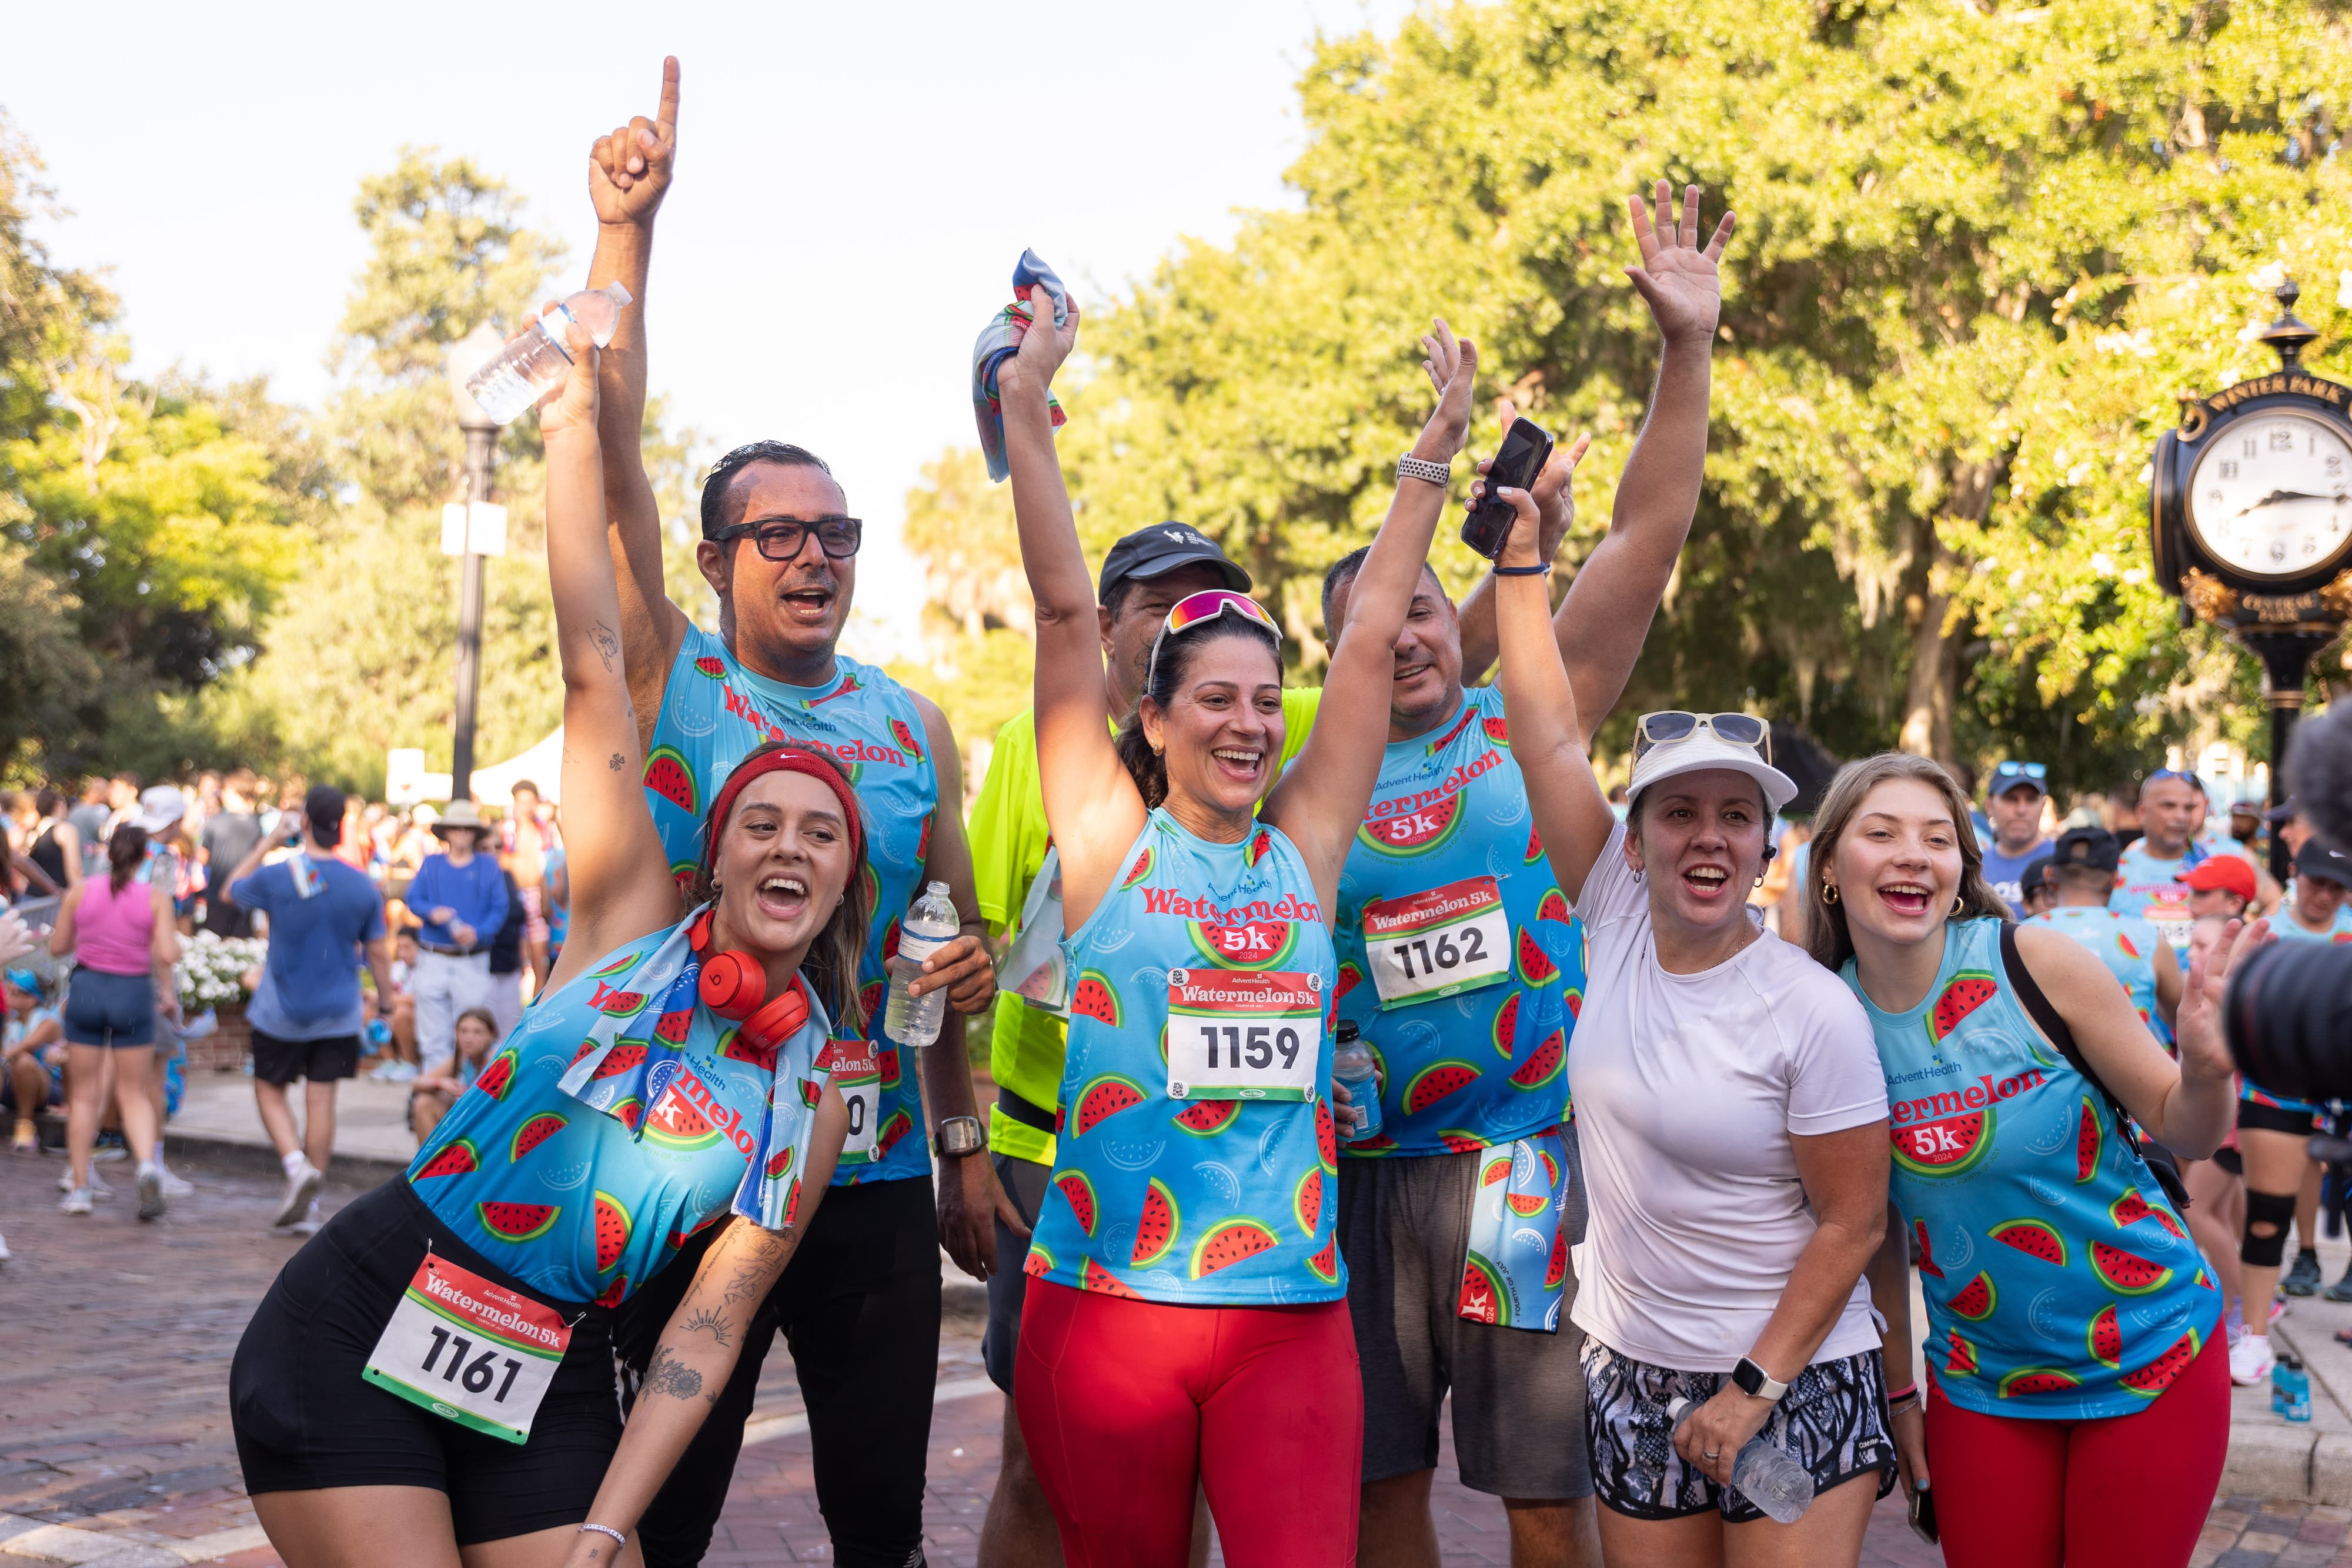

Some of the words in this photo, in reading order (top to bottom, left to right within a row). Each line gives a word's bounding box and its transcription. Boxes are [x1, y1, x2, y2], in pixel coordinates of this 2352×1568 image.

[2208, 375, 2287, 412] WINTER
[2289, 375, 2343, 404] PARK
[1375, 765, 1444, 792] AdventHealth
[1391, 813, 1440, 840] 5k
[1406, 833, 1428, 845] 2024
[1426, 844, 1452, 862] FOURTH
[1452, 836, 1460, 845] OF
[1459, 818, 1469, 835] JULY
[1138, 885, 1322, 927] Watermelon
[1371, 897, 1470, 931] Watermelon
[1469, 890, 1494, 905] 5k
[1412, 893, 1444, 905] AdventHealth
[1223, 925, 1272, 951] 5k
[1238, 951, 1258, 959] 2024
[1288, 957, 1300, 972] JULY
[1393, 927, 1489, 980] 1162
[1180, 985, 1295, 1004] Watermelon
[1296, 991, 1316, 1005] 5k
[1200, 1027, 1300, 1069] 1159
[830, 1057, 862, 1072] elon
[862, 1058, 876, 1072] 5k
[1887, 1062, 1963, 1086] AdventHealth
[674, 1062, 758, 1164] melo
[1913, 1125, 1965, 1155] 5k
[1932, 1152, 1953, 1163] 2024
[1956, 1170, 1982, 1186] FOURTH
[1981, 1162, 1990, 1172] OF
[1989, 1147, 2002, 1164] JULY
[1495, 1260, 1509, 1275] JULY
[1505, 1276, 1514, 1286] OF
[425, 1271, 539, 1338] Watermelon
[538, 1329, 561, 1348] 5k
[483, 1289, 522, 1310] AdventHealth
[1511, 1286, 1521, 1316] FOURTH
[476, 1316, 490, 1326] FOURTH
[421, 1325, 523, 1403] 1161
[1859, 1440, 1870, 1449] Calvin
